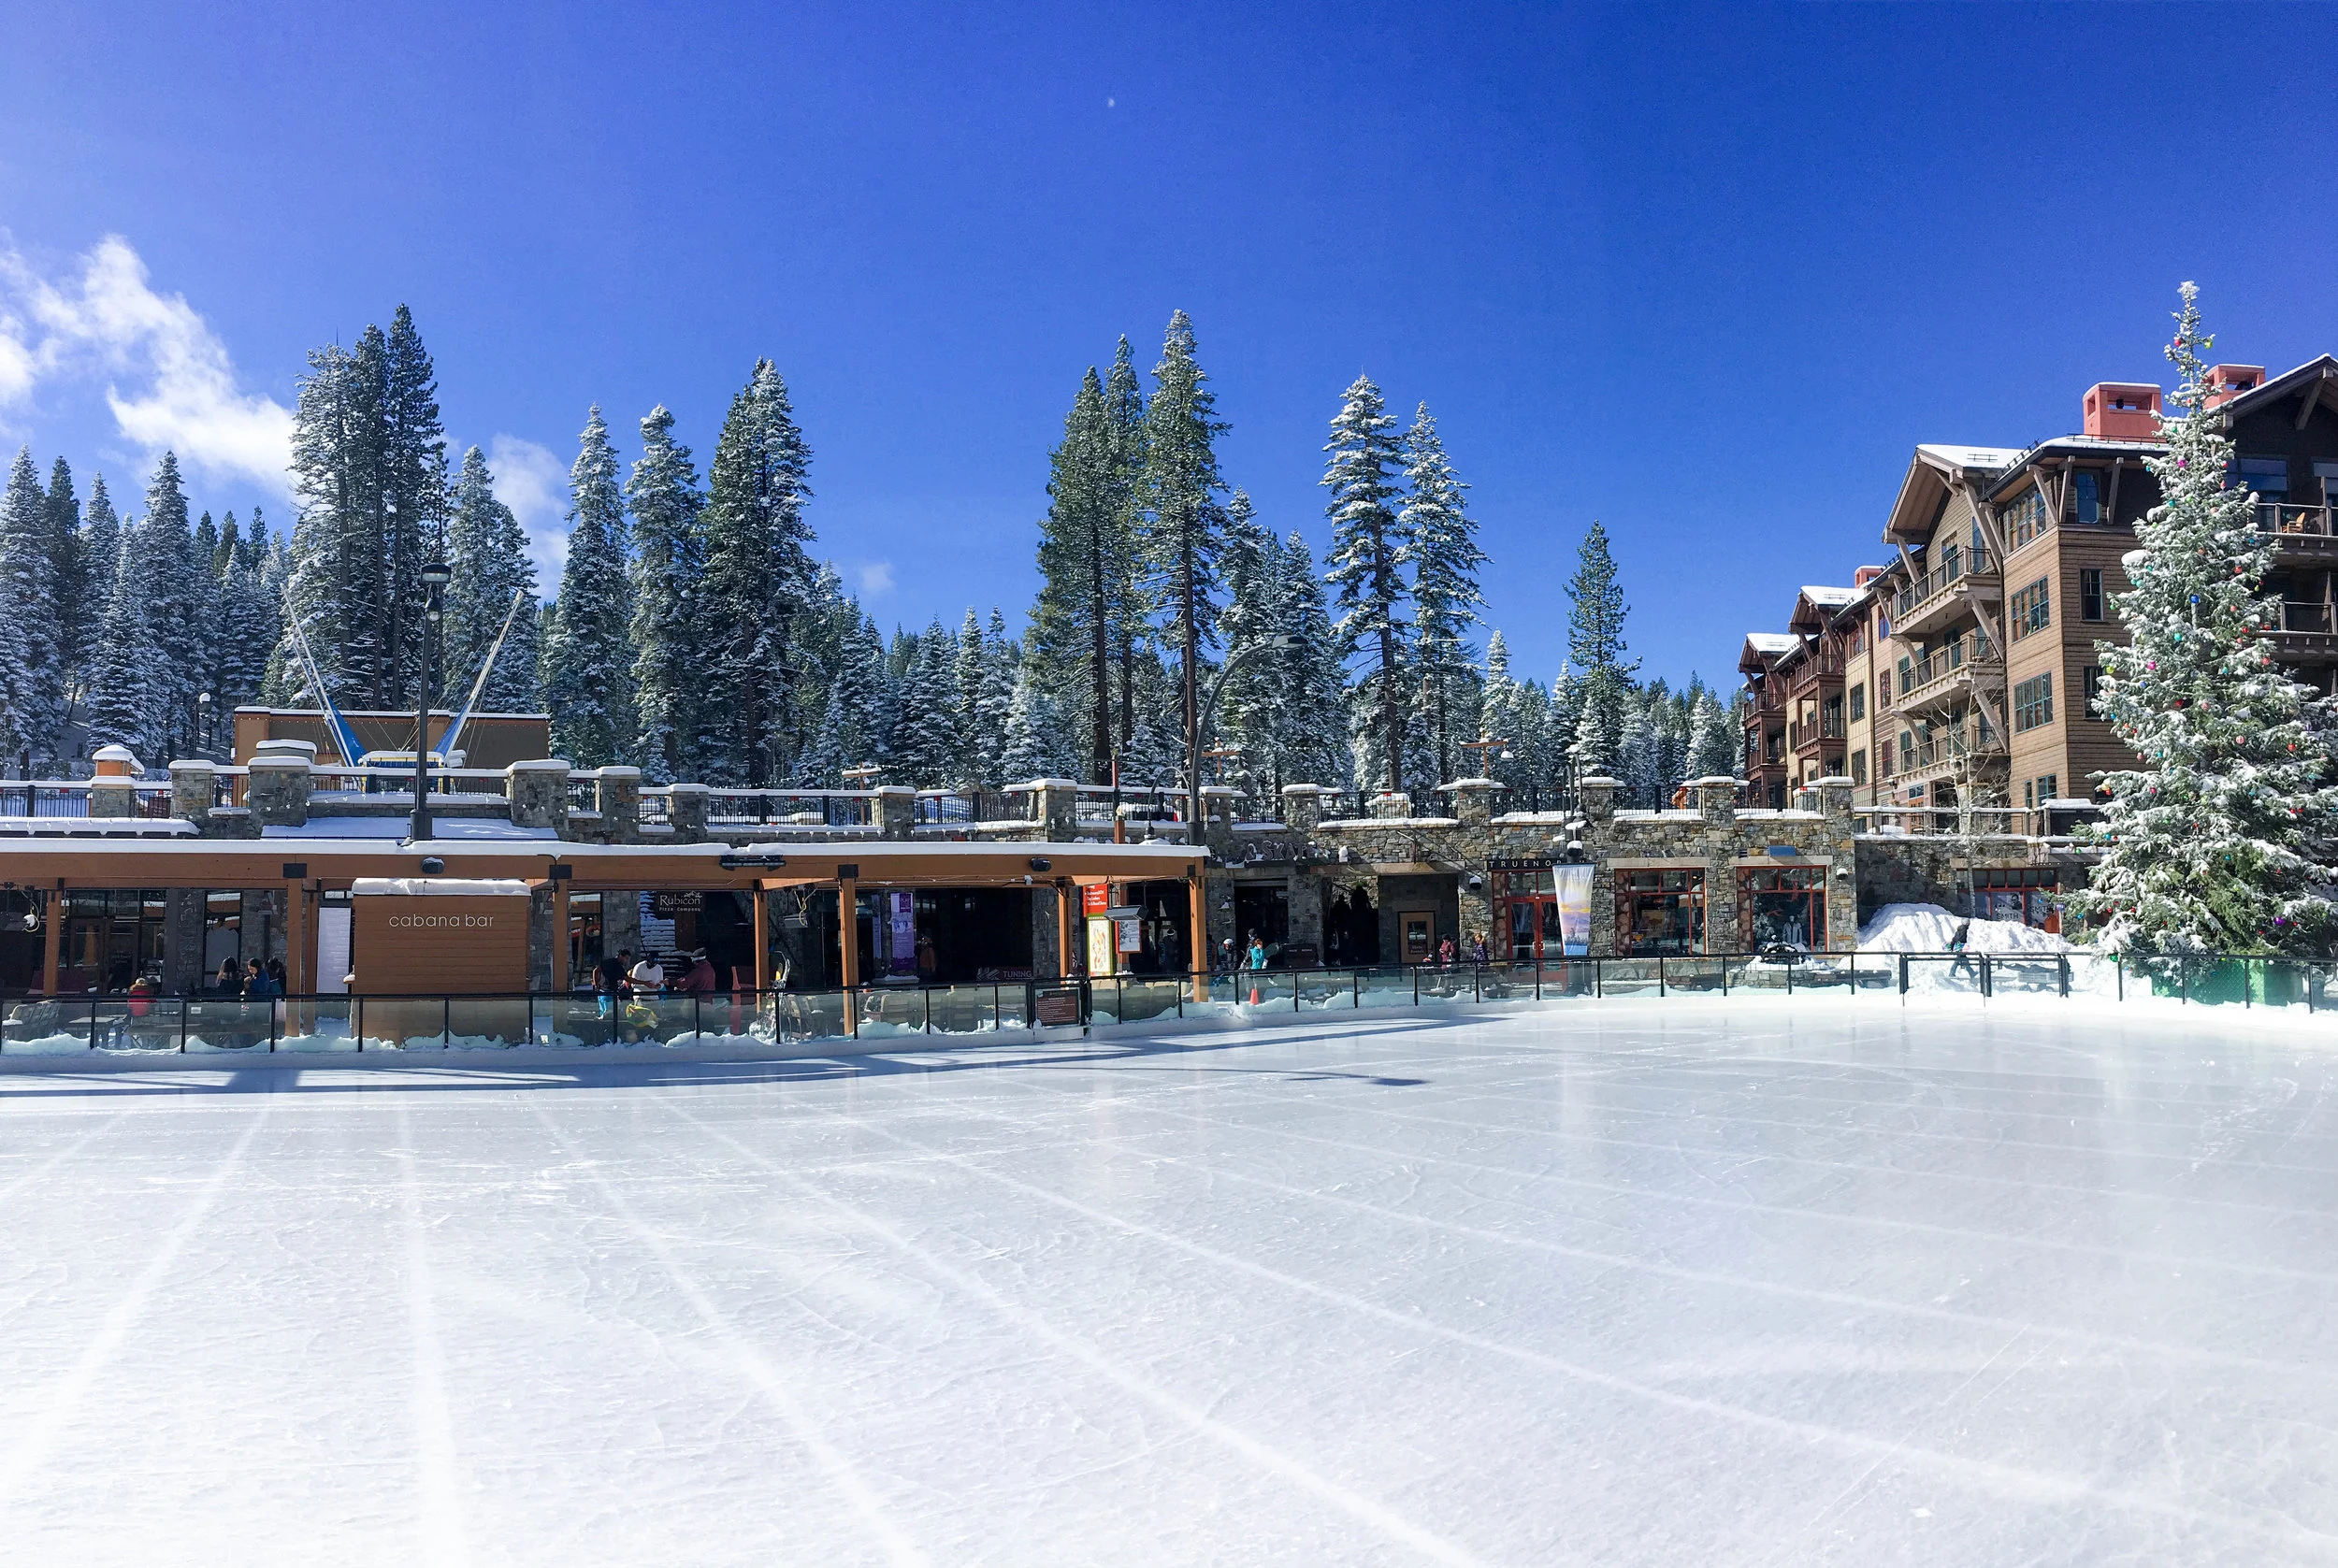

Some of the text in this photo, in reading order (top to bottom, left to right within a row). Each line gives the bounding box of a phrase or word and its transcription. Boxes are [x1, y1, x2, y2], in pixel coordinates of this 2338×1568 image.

[659, 894, 700, 906] Rubicon
[389, 913, 494, 928] cabana bar
